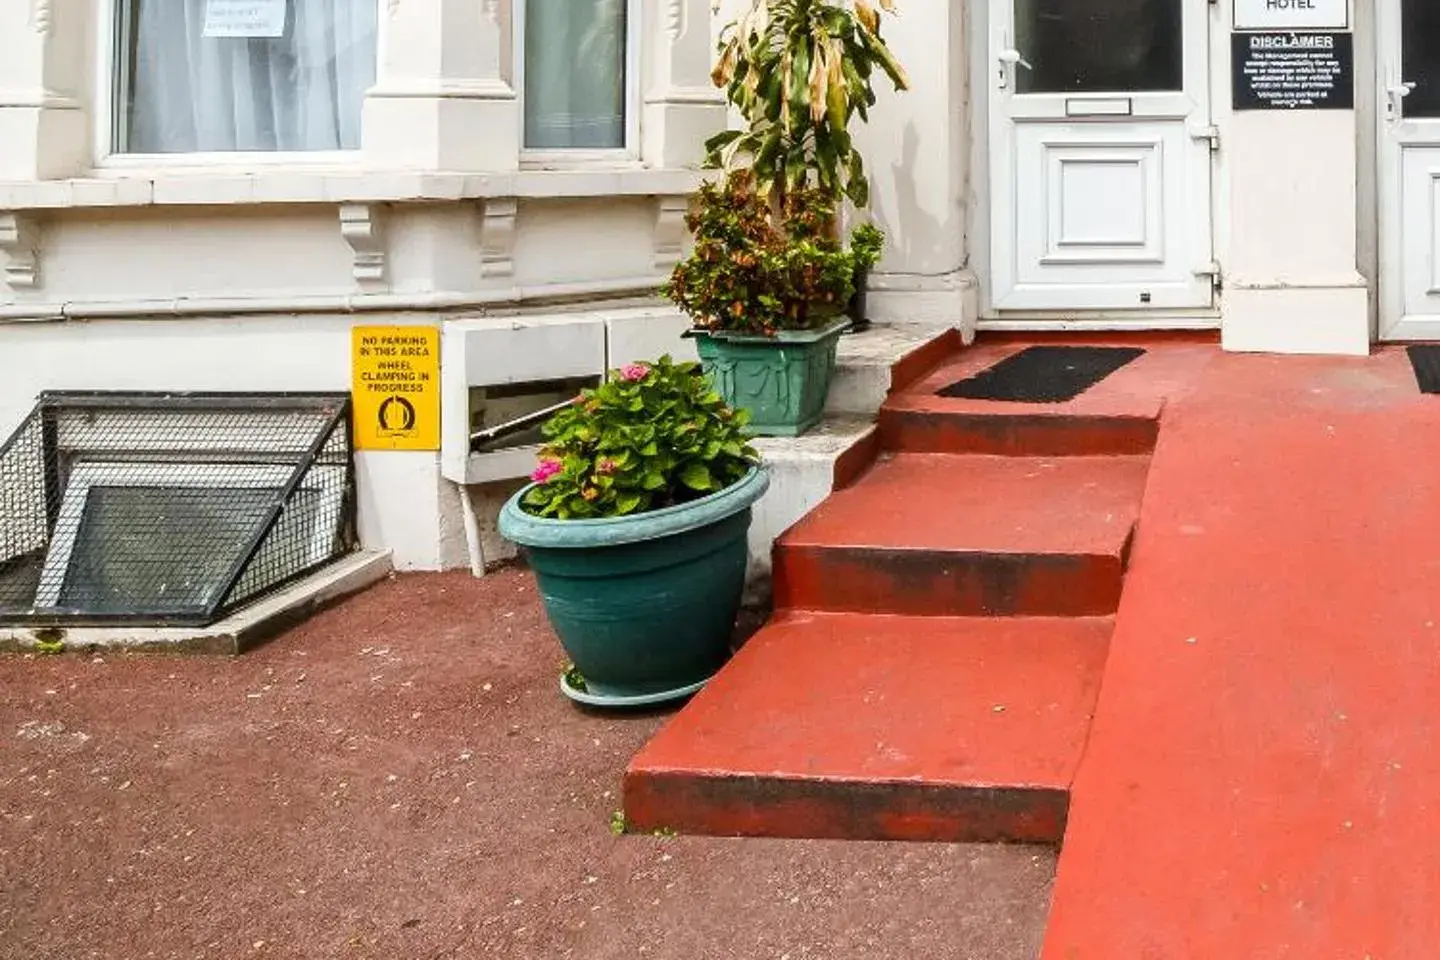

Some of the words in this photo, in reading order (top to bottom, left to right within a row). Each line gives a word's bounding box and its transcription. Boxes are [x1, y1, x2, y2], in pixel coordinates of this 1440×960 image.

[1250, 36, 1333, 48] DISCLAIMER
[362, 336, 377, 345] NO
[381, 336, 427, 345] PARKING
[360, 347, 369, 356] IN
[374, 347, 396, 356] THIS
[401, 347, 429, 356] AREA
[378, 361, 412, 370] WHEEL
[361, 372, 415, 381] CLAMPING
[418, 372, 429, 381] IN
[367, 384, 423, 392] PROGRESS
